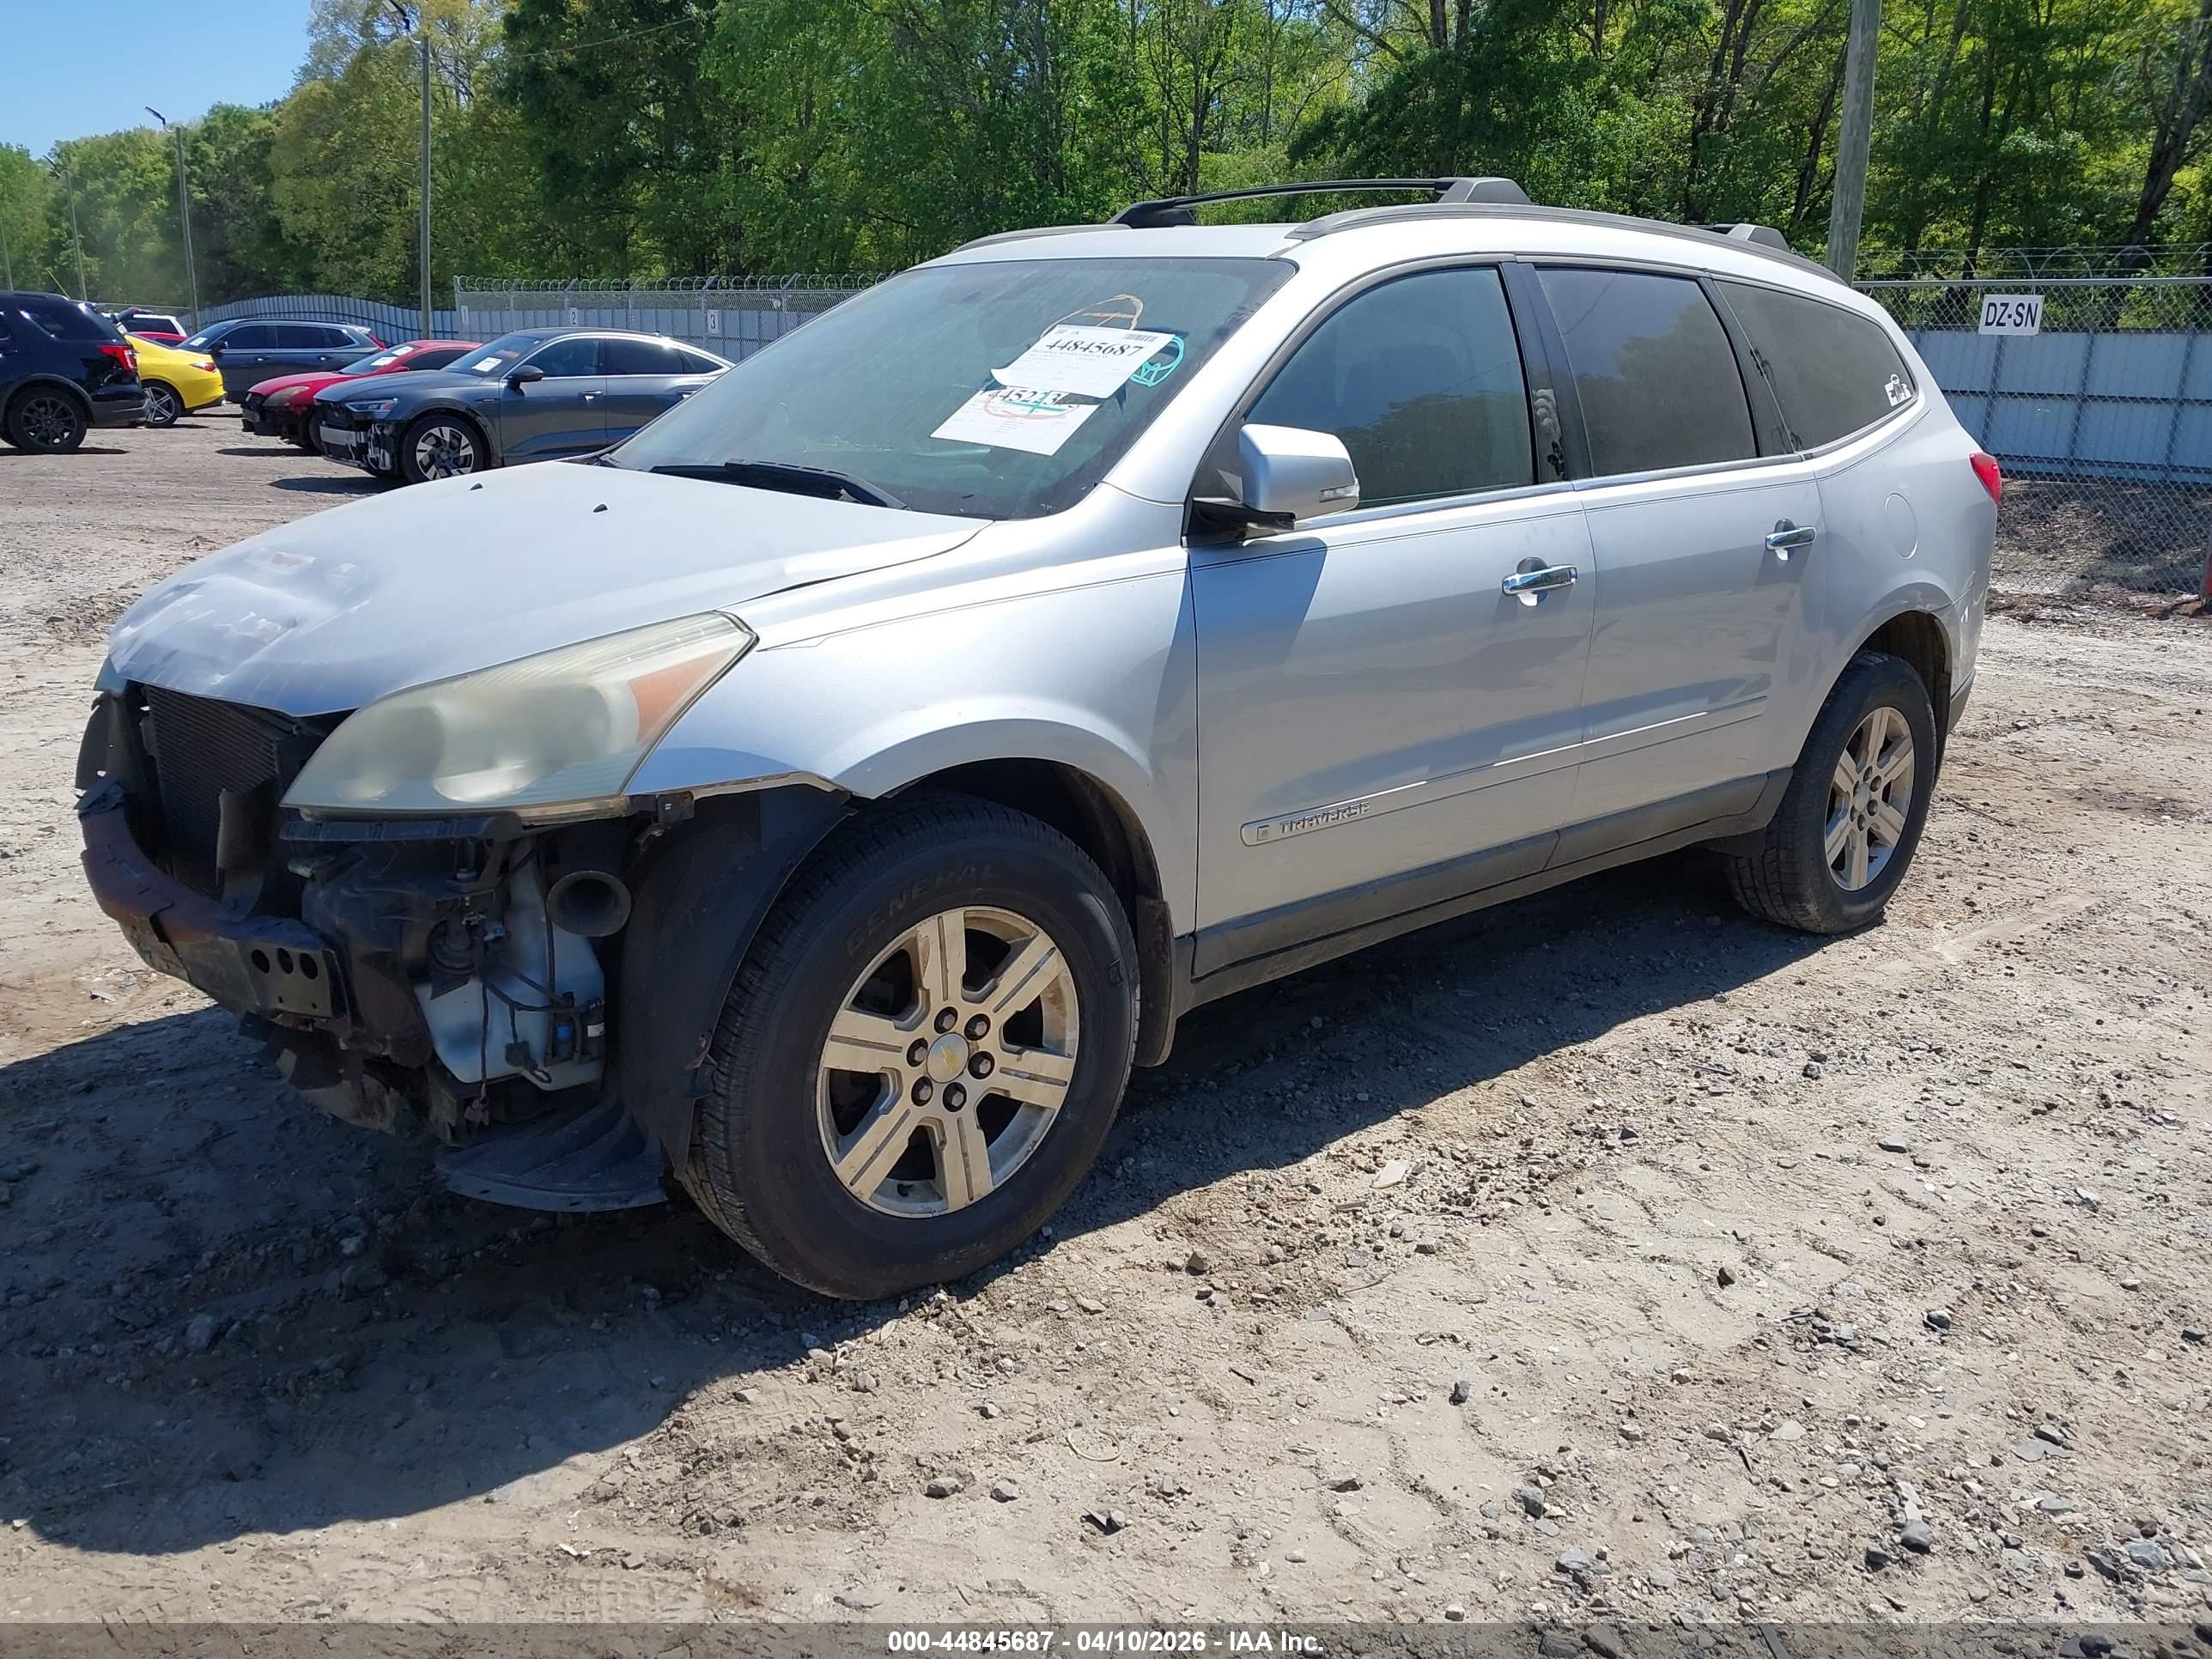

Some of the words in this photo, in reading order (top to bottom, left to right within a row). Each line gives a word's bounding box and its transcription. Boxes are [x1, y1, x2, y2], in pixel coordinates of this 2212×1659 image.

[570, 311, 576, 325] 2
[710, 313, 716, 330] 3
[1984, 302, 2039, 327] DZ-SN
[1045, 337, 1145, 357] 44845687
[1279, 802, 1370, 833] TRAVERSE
